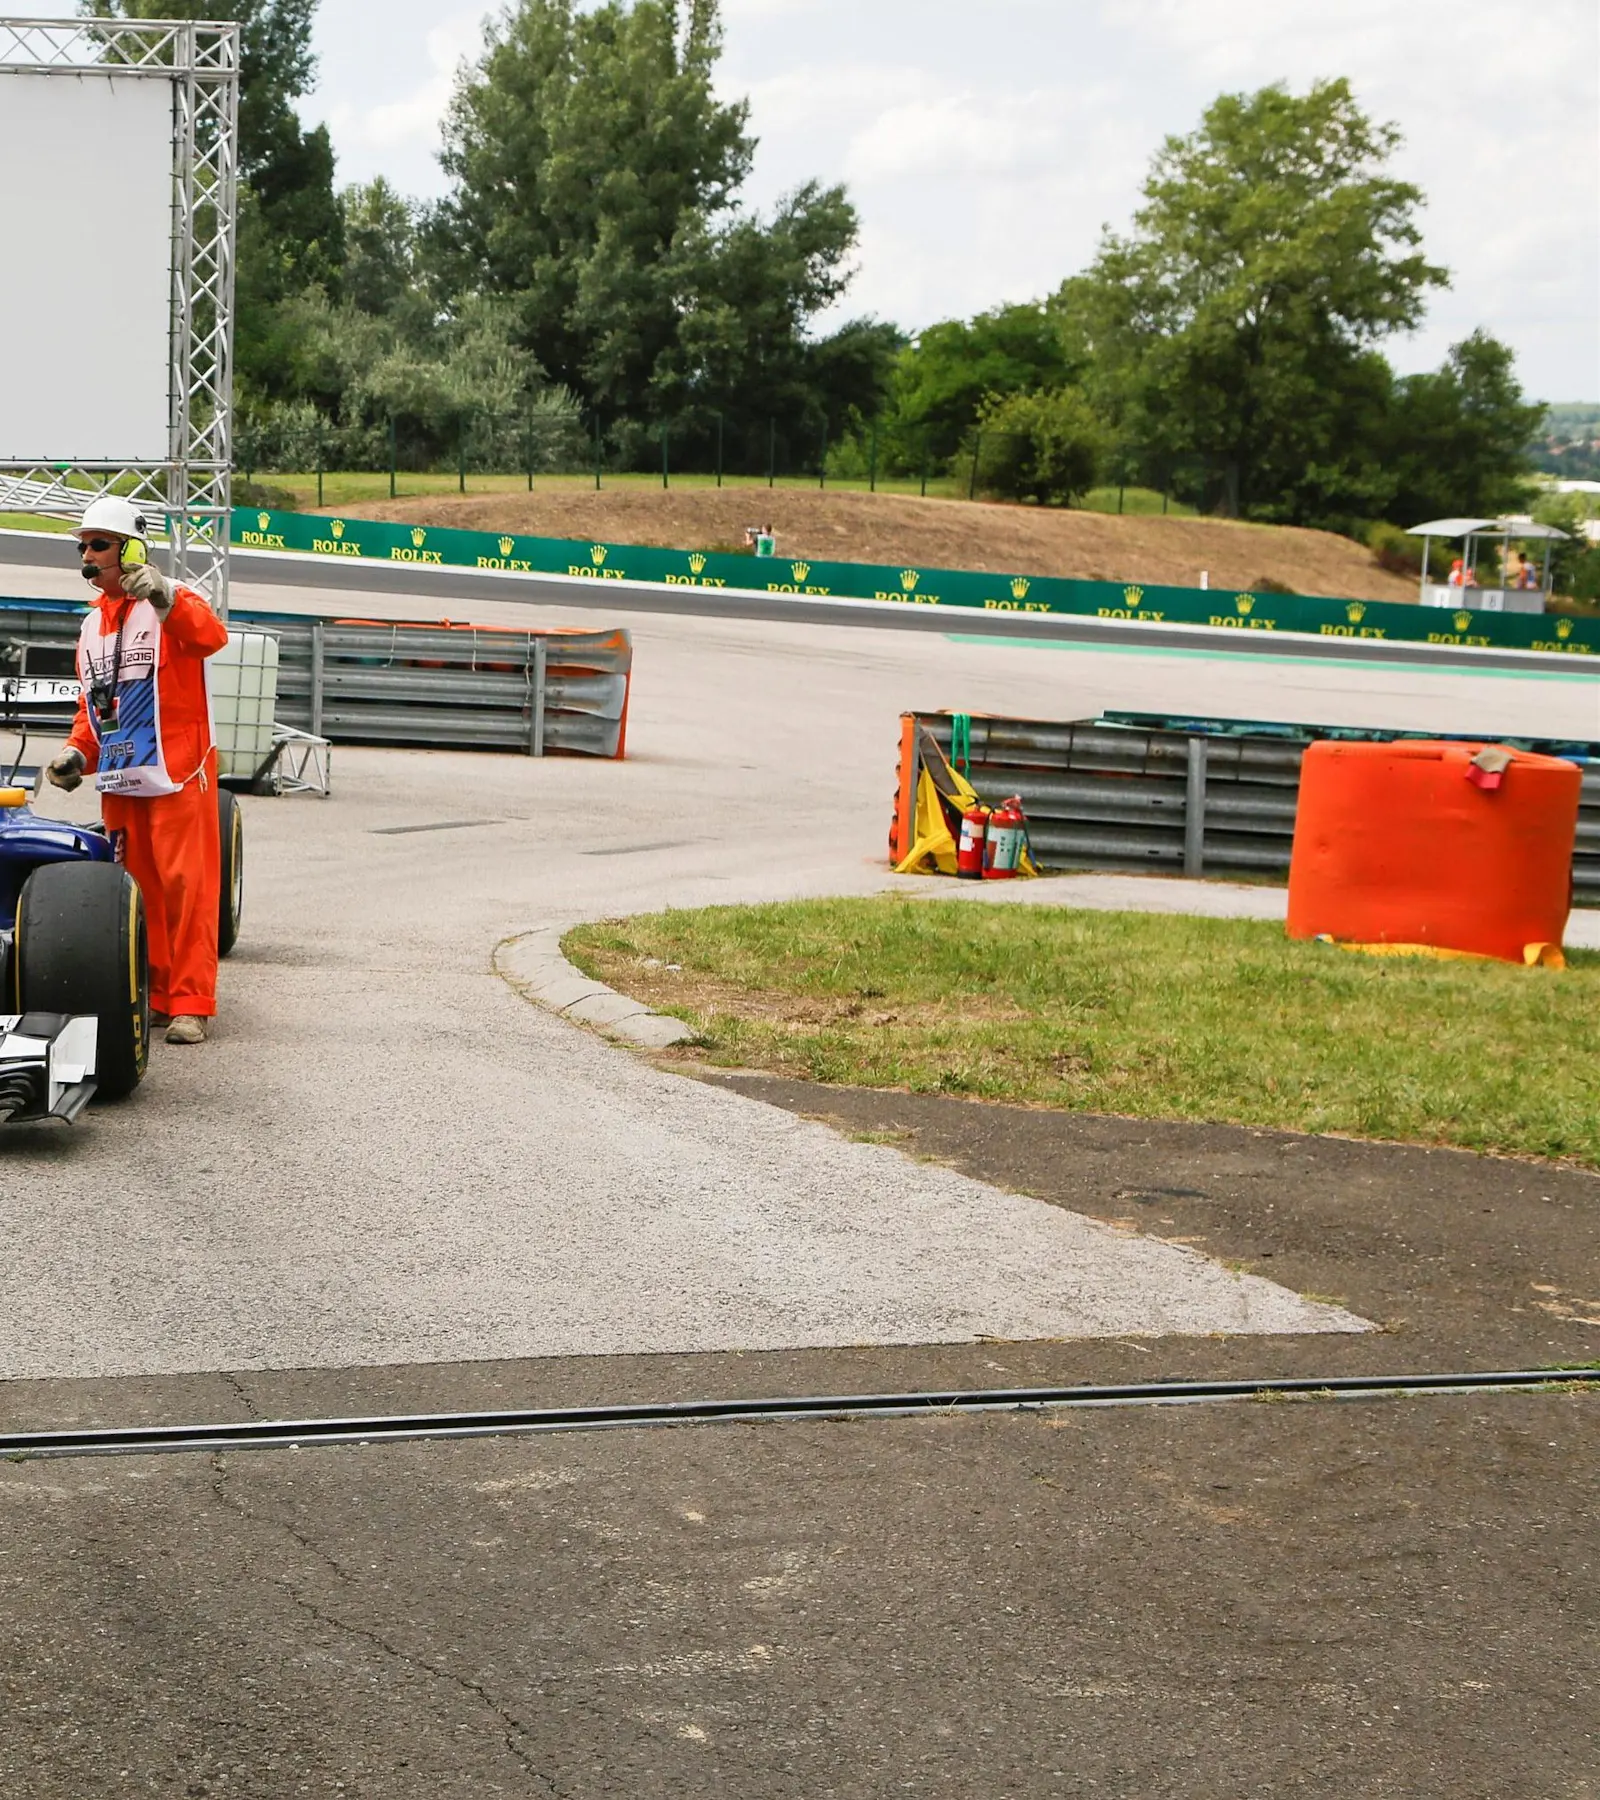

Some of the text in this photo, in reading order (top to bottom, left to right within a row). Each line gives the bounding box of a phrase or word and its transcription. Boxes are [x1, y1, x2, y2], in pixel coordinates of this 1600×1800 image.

[242, 531, 285, 548] ROLEX
[313, 539, 361, 556] ROLEX
[391, 547, 442, 564] ROLEX
[477, 556, 532, 572] ROLEX
[126, 651, 152, 663] 2016
[17, 680, 38, 695] F1
[48, 681, 82, 695] Tea
